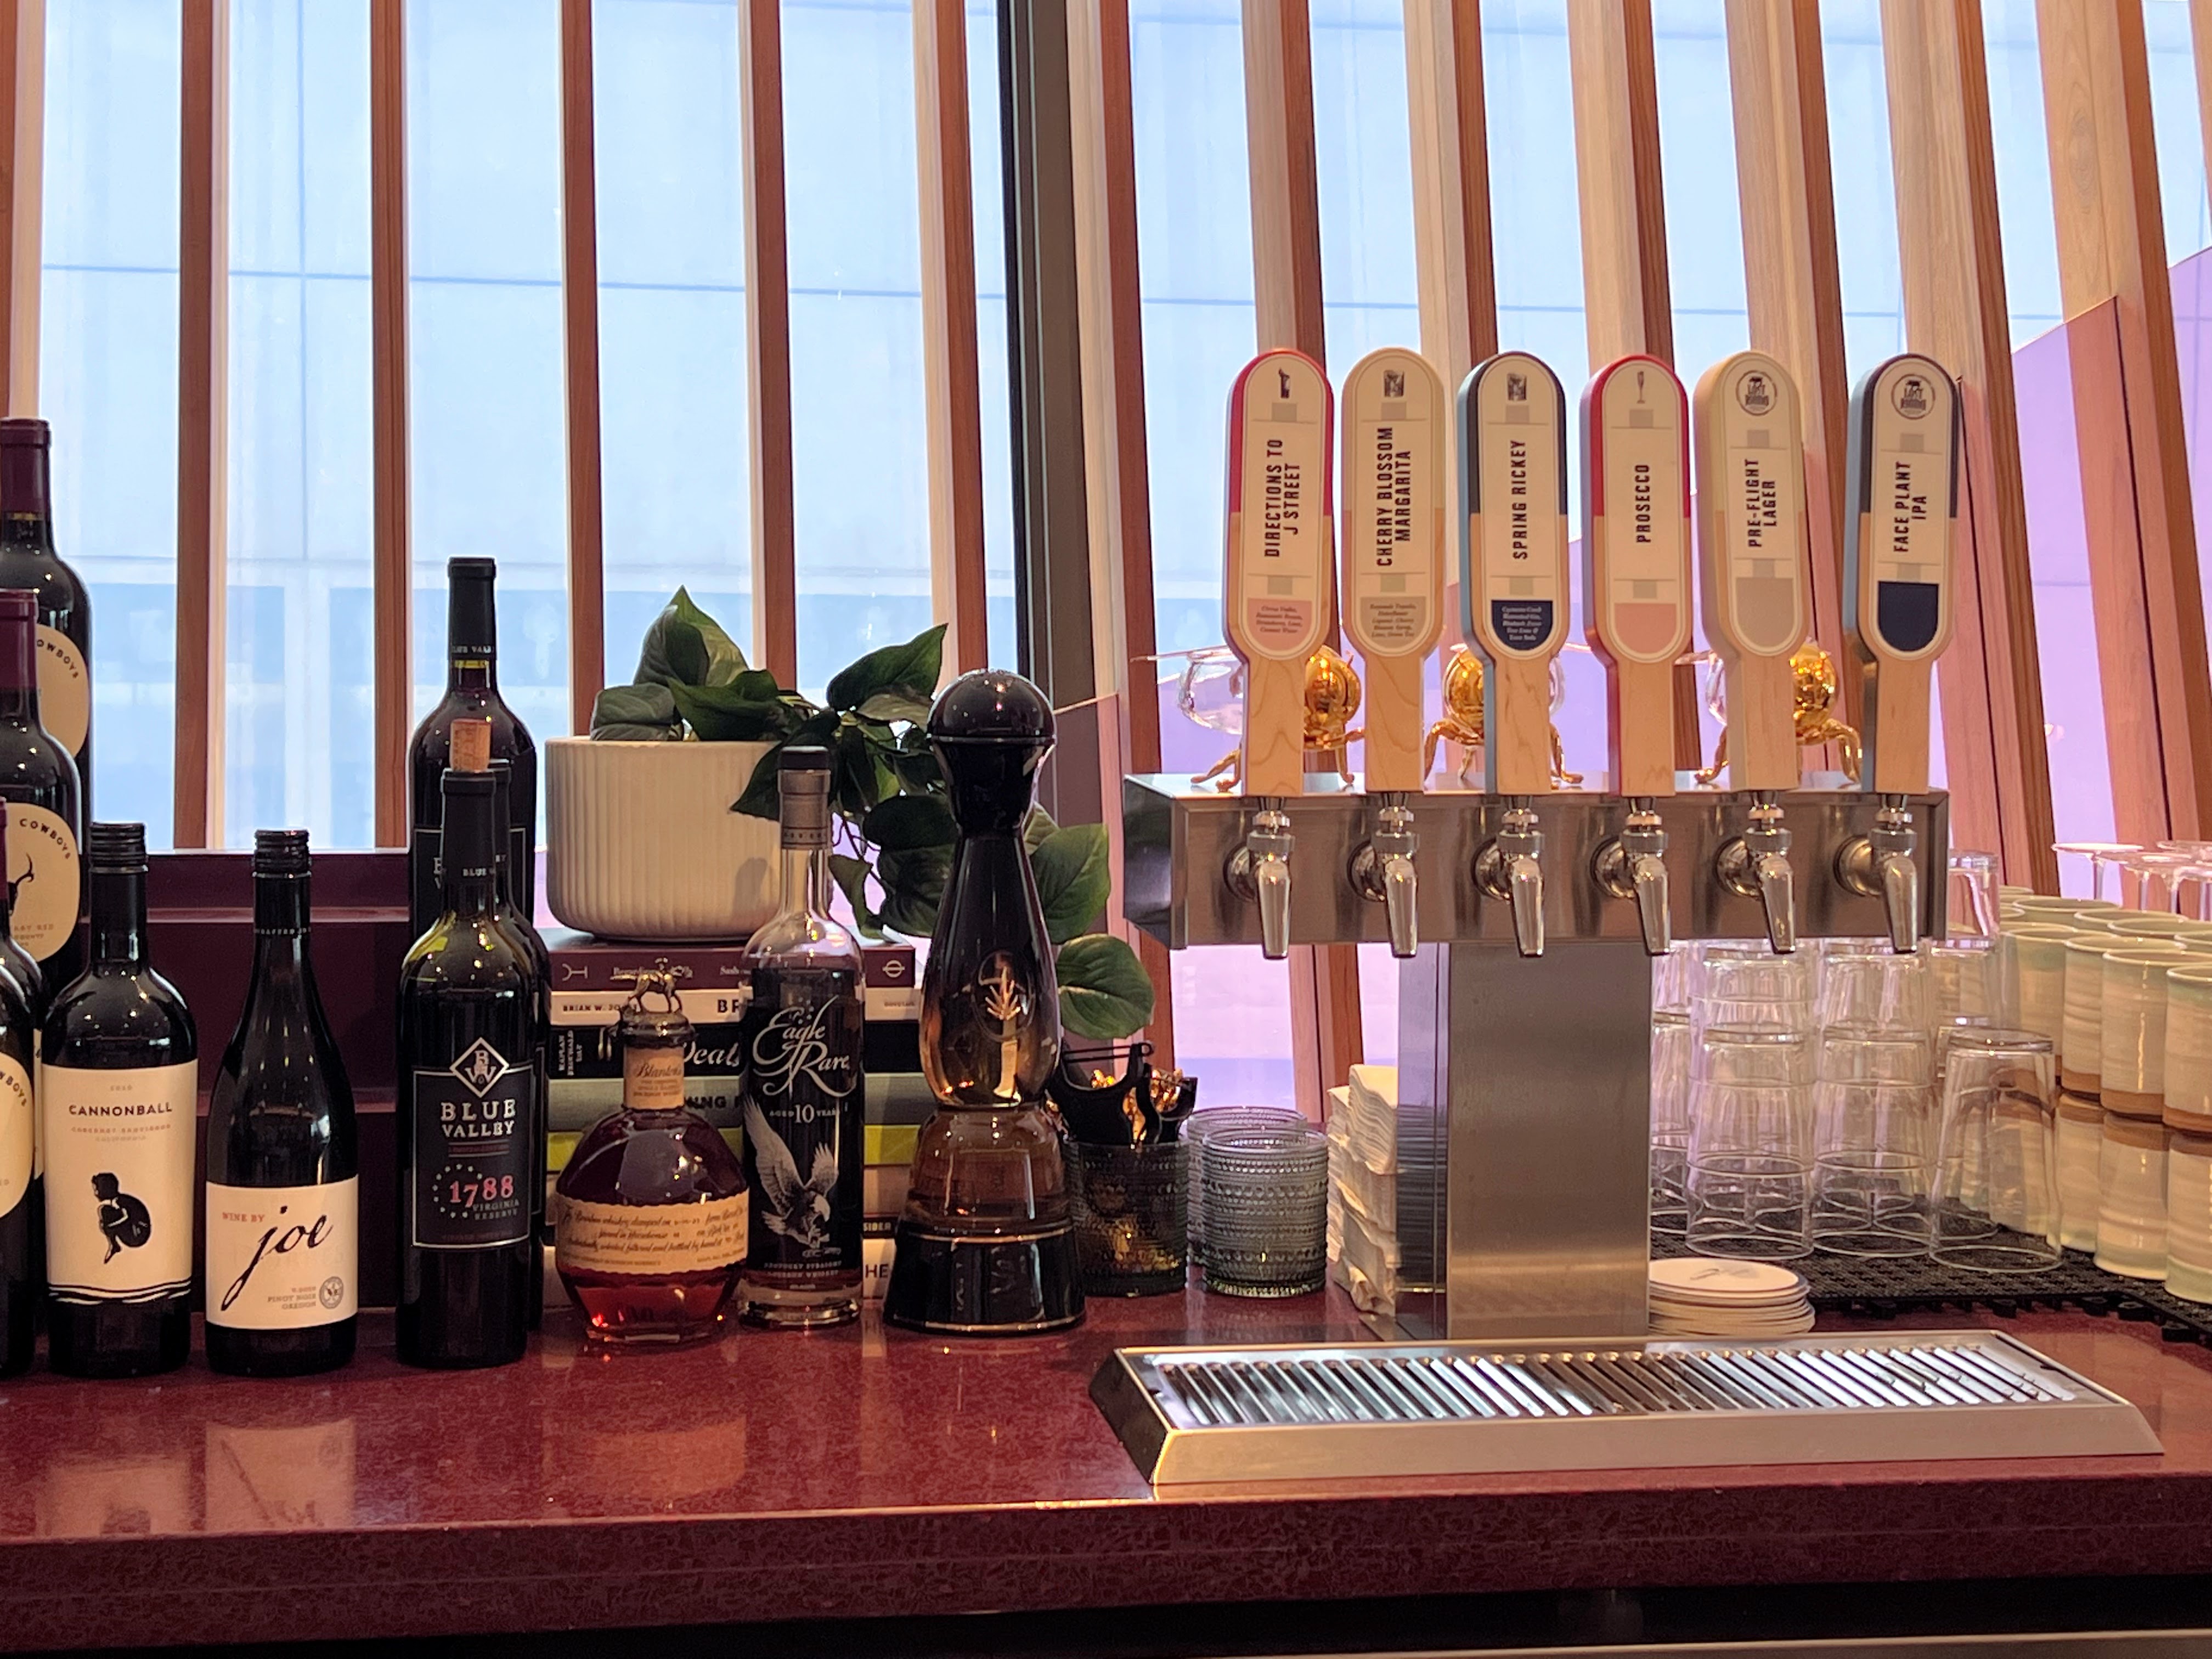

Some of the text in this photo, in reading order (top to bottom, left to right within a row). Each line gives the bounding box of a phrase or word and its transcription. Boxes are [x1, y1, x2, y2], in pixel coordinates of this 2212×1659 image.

[1264, 439, 1283, 557] DIRECTIONS TO
[1283, 462, 1300, 535] J STREET
[1376, 427, 1393, 566] CHERRY BLOSSOM
[1395, 451, 1411, 541] MARGARITA
[1510, 440, 1528, 560] SPRING RICKEY
[1634, 465, 1651, 543] PROSECCO
[1744, 459, 1762, 548] PRE-FLIGHT
[1762, 481, 1777, 527] LAGER
[1893, 461, 1911, 552] FACE PLANT
[1911, 496, 1927, 520] IPA
[36, 639, 79, 679] OWBOYS
[19, 817, 71, 860] COWBOYS
[763, 1041, 857, 1097] Rare
[69, 1102, 173, 1116] CANNONBALL
[441, 1099, 516, 1121] BLUE
[442, 1120, 515, 1138] VALLEY
[795, 1104, 815, 1123] 10
[222, 1212, 265, 1222] WINE BY
[449, 1175, 514, 1208] 1788
[221, 1205, 334, 1311] joe
